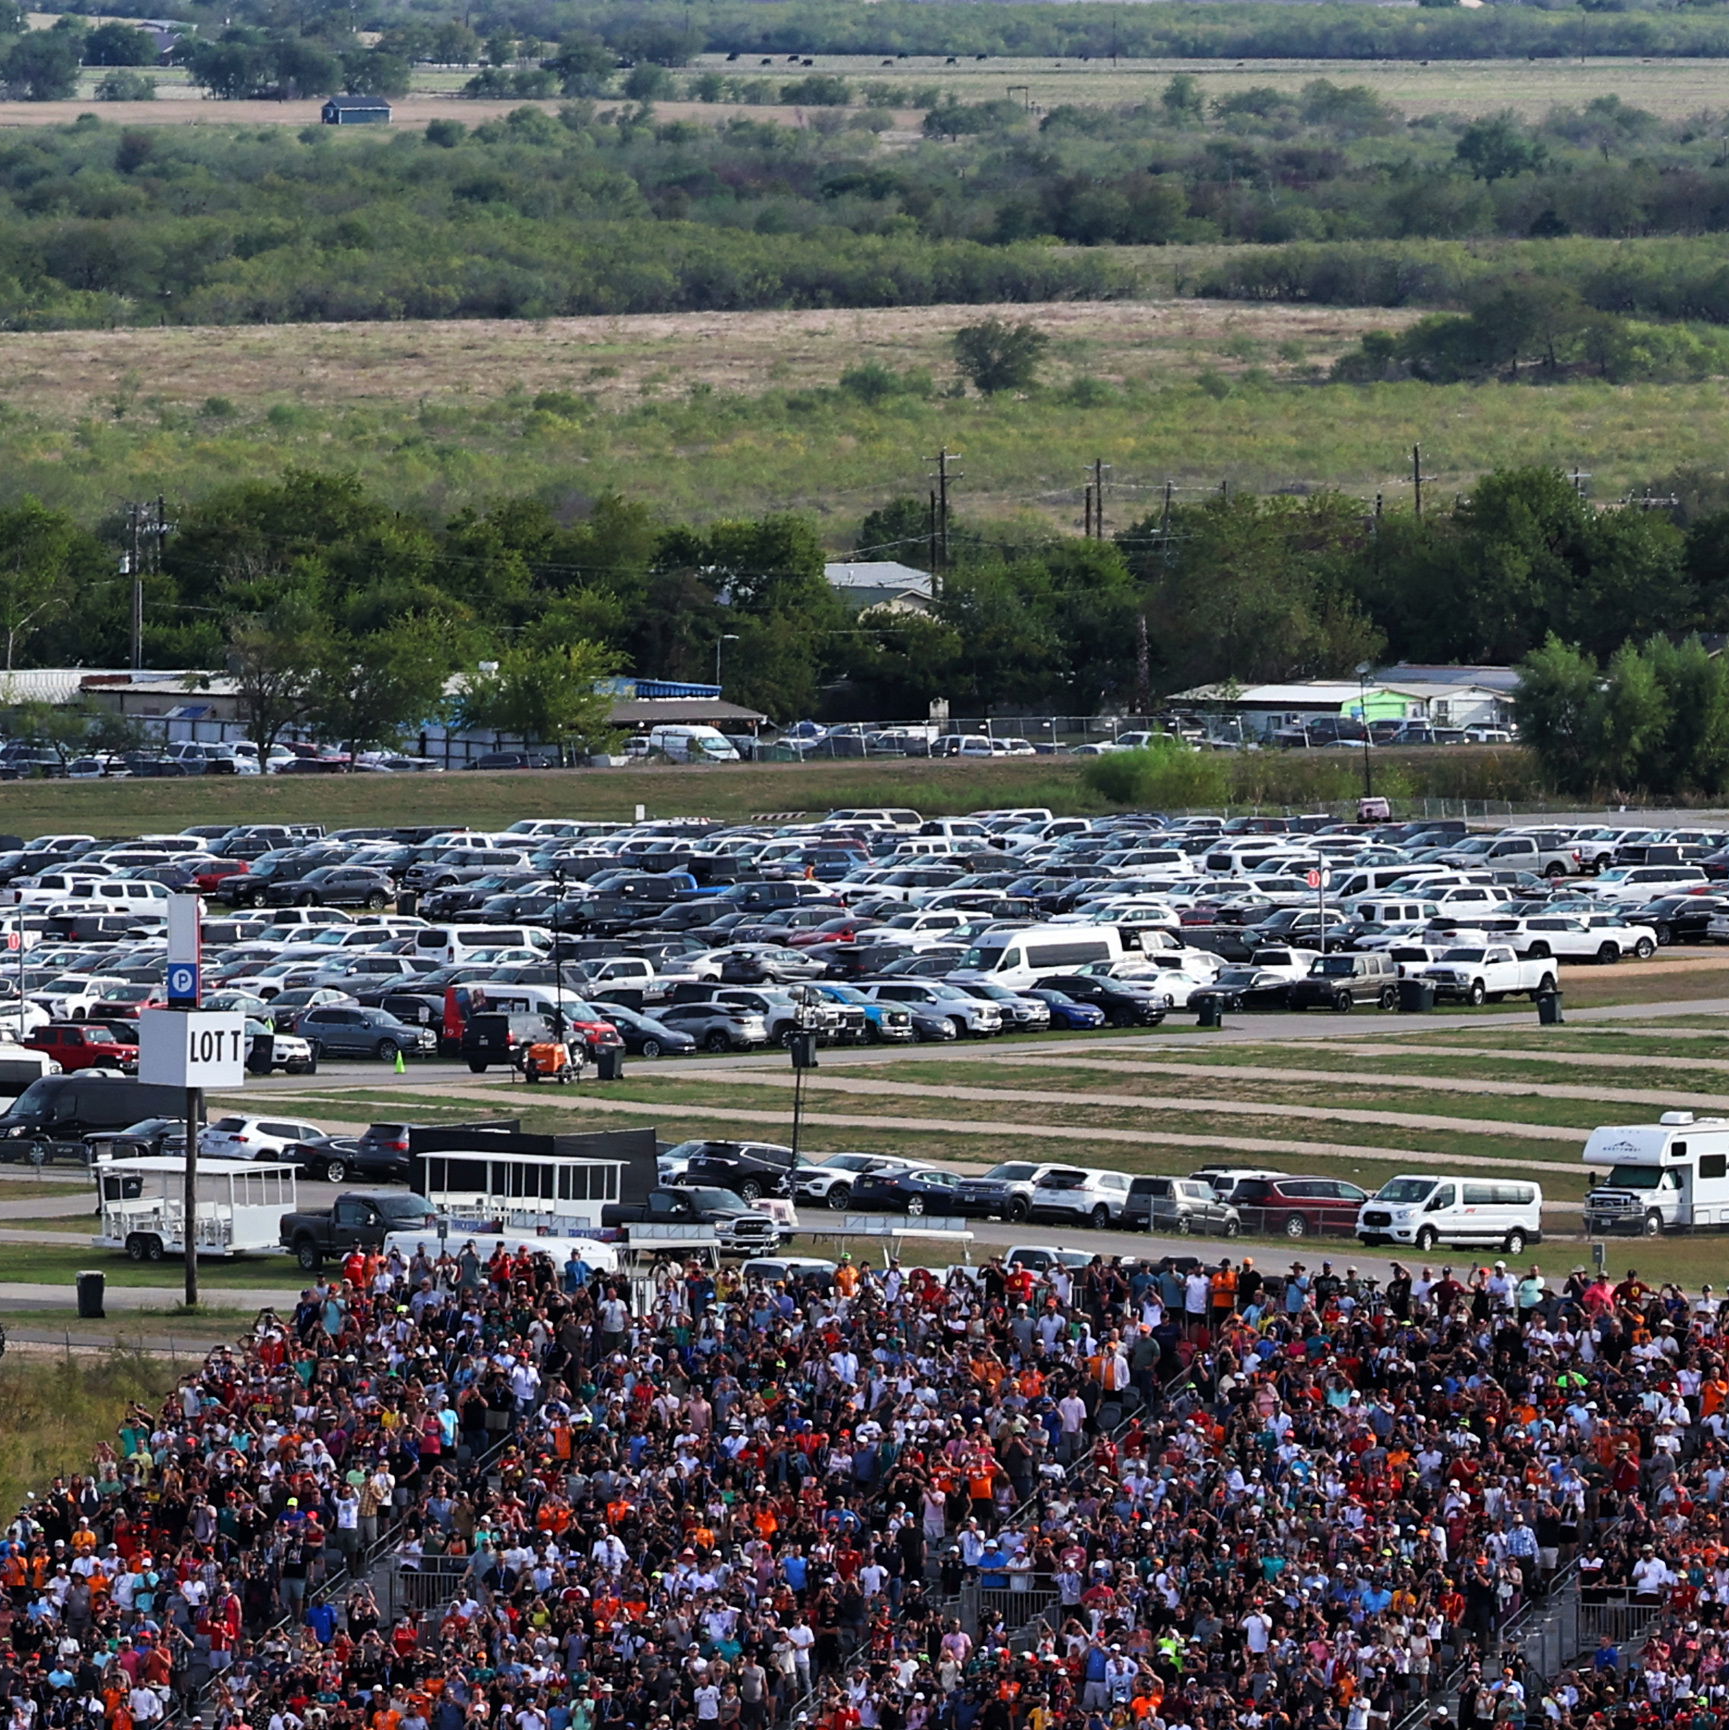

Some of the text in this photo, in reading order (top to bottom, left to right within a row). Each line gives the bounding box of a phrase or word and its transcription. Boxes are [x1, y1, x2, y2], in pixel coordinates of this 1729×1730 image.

[178, 973, 189, 989] P
[190, 1030, 242, 1063] LOT T
